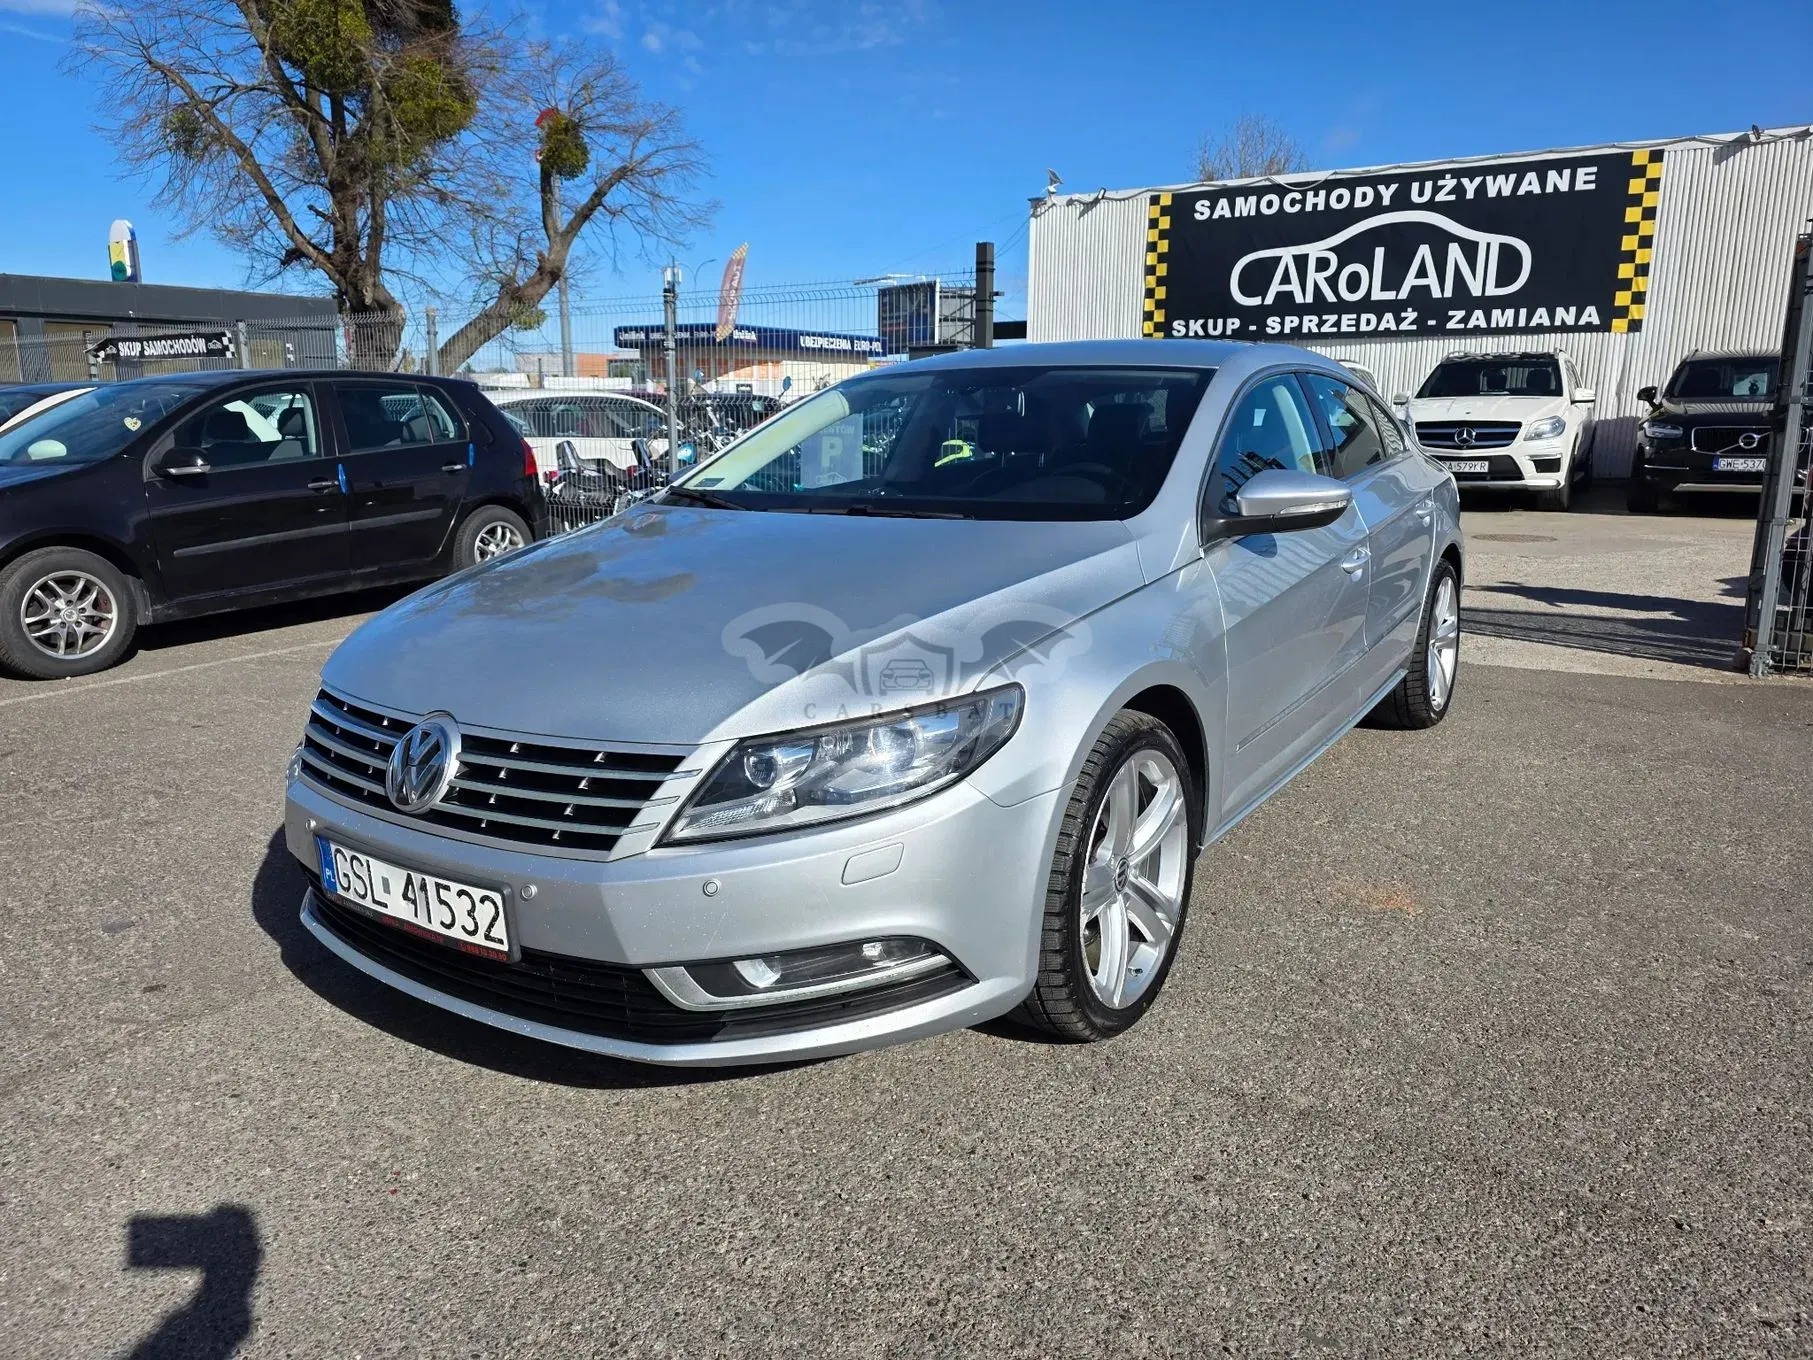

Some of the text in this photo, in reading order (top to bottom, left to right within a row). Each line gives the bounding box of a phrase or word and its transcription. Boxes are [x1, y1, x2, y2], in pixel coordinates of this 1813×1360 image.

[1194, 166, 1598, 221] SAMOCHODY UŻYWANE
[1171, 318, 1241, 337] SKUP
[1265, 308, 1418, 334] SPRZEDAŻ
[1446, 305, 1601, 329] ZAMIANA
[118, 341, 142, 357] SKUP
[143, 335, 207, 357] SAMOCHODÓW
[1719, 459, 1739, 469] GWE
[324, 868, 336, 883] PL
[334, 847, 389, 909] GSL
[401, 871, 505, 946] 41532
